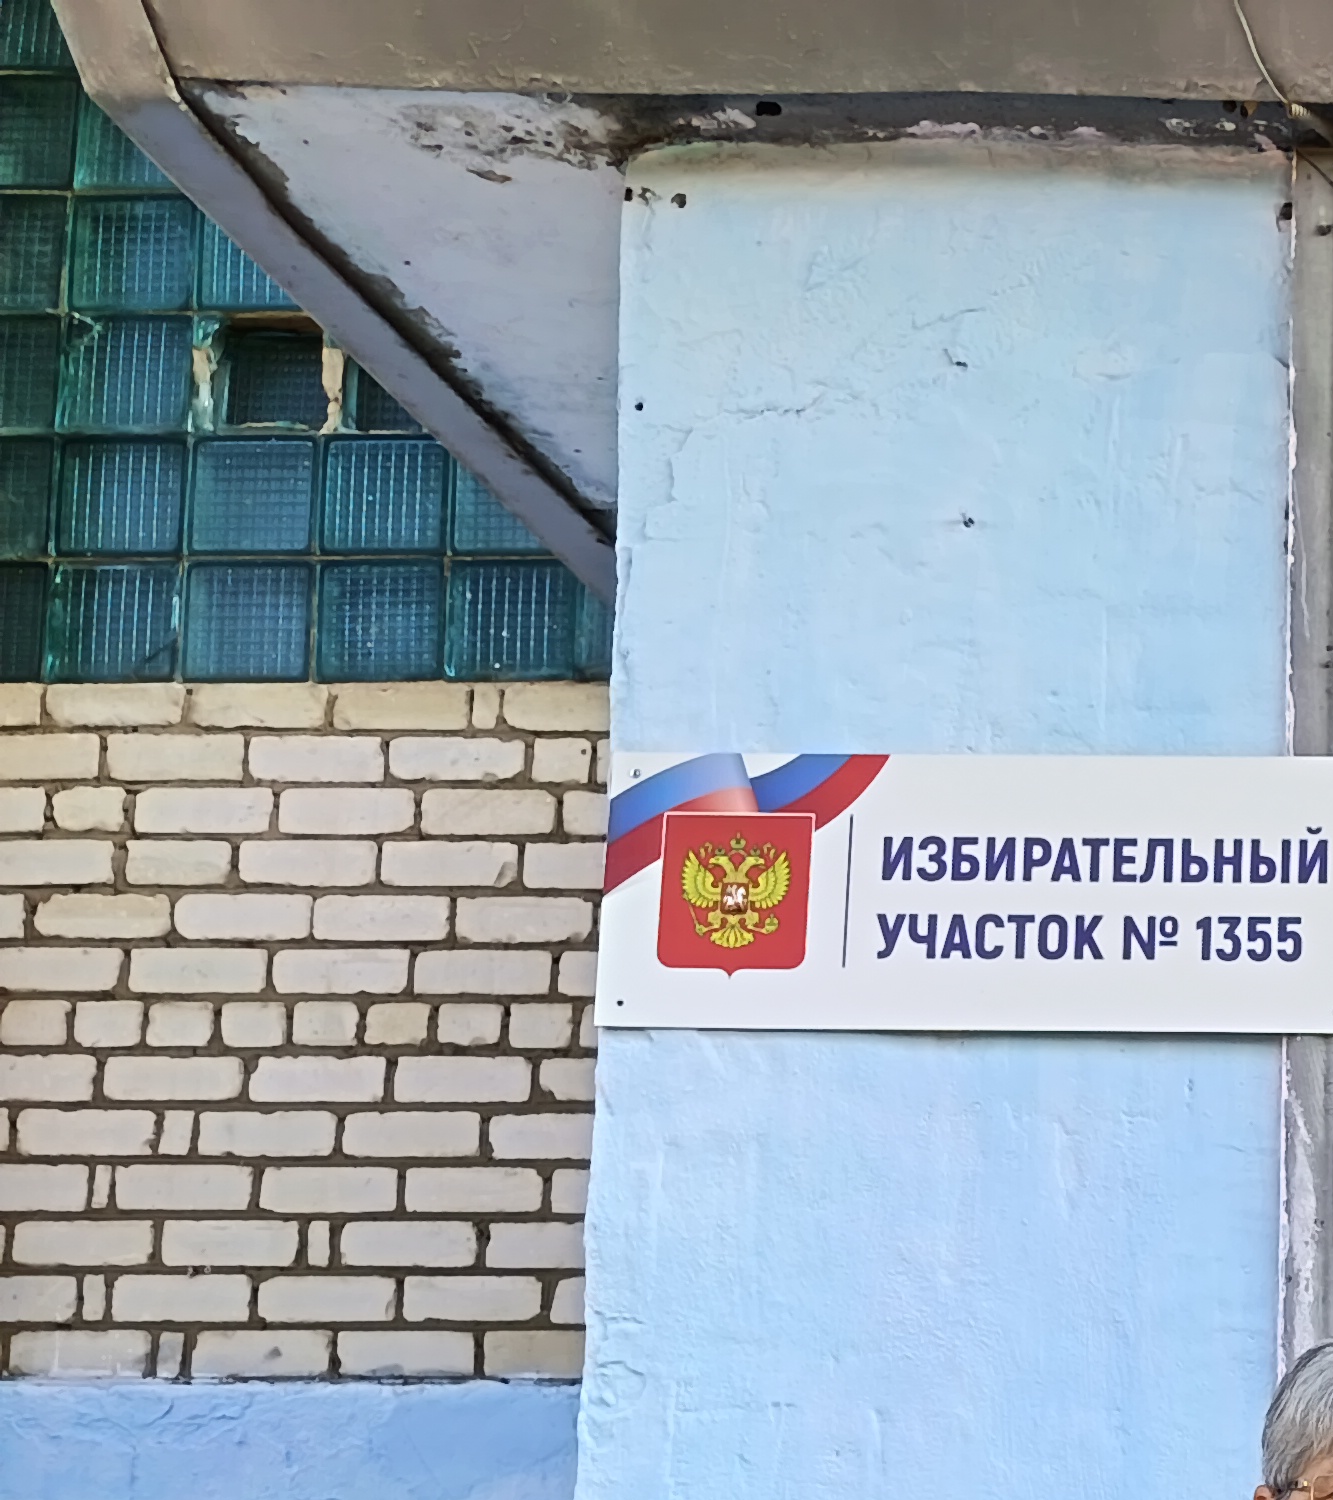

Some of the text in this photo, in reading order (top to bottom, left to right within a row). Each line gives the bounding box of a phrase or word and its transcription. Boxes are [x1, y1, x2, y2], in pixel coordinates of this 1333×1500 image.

[881, 826, 1329, 884] ИЗБИРАТЕЛЬНЫЙ
[876, 913, 1302, 963] УЧАСТОК № 1355
